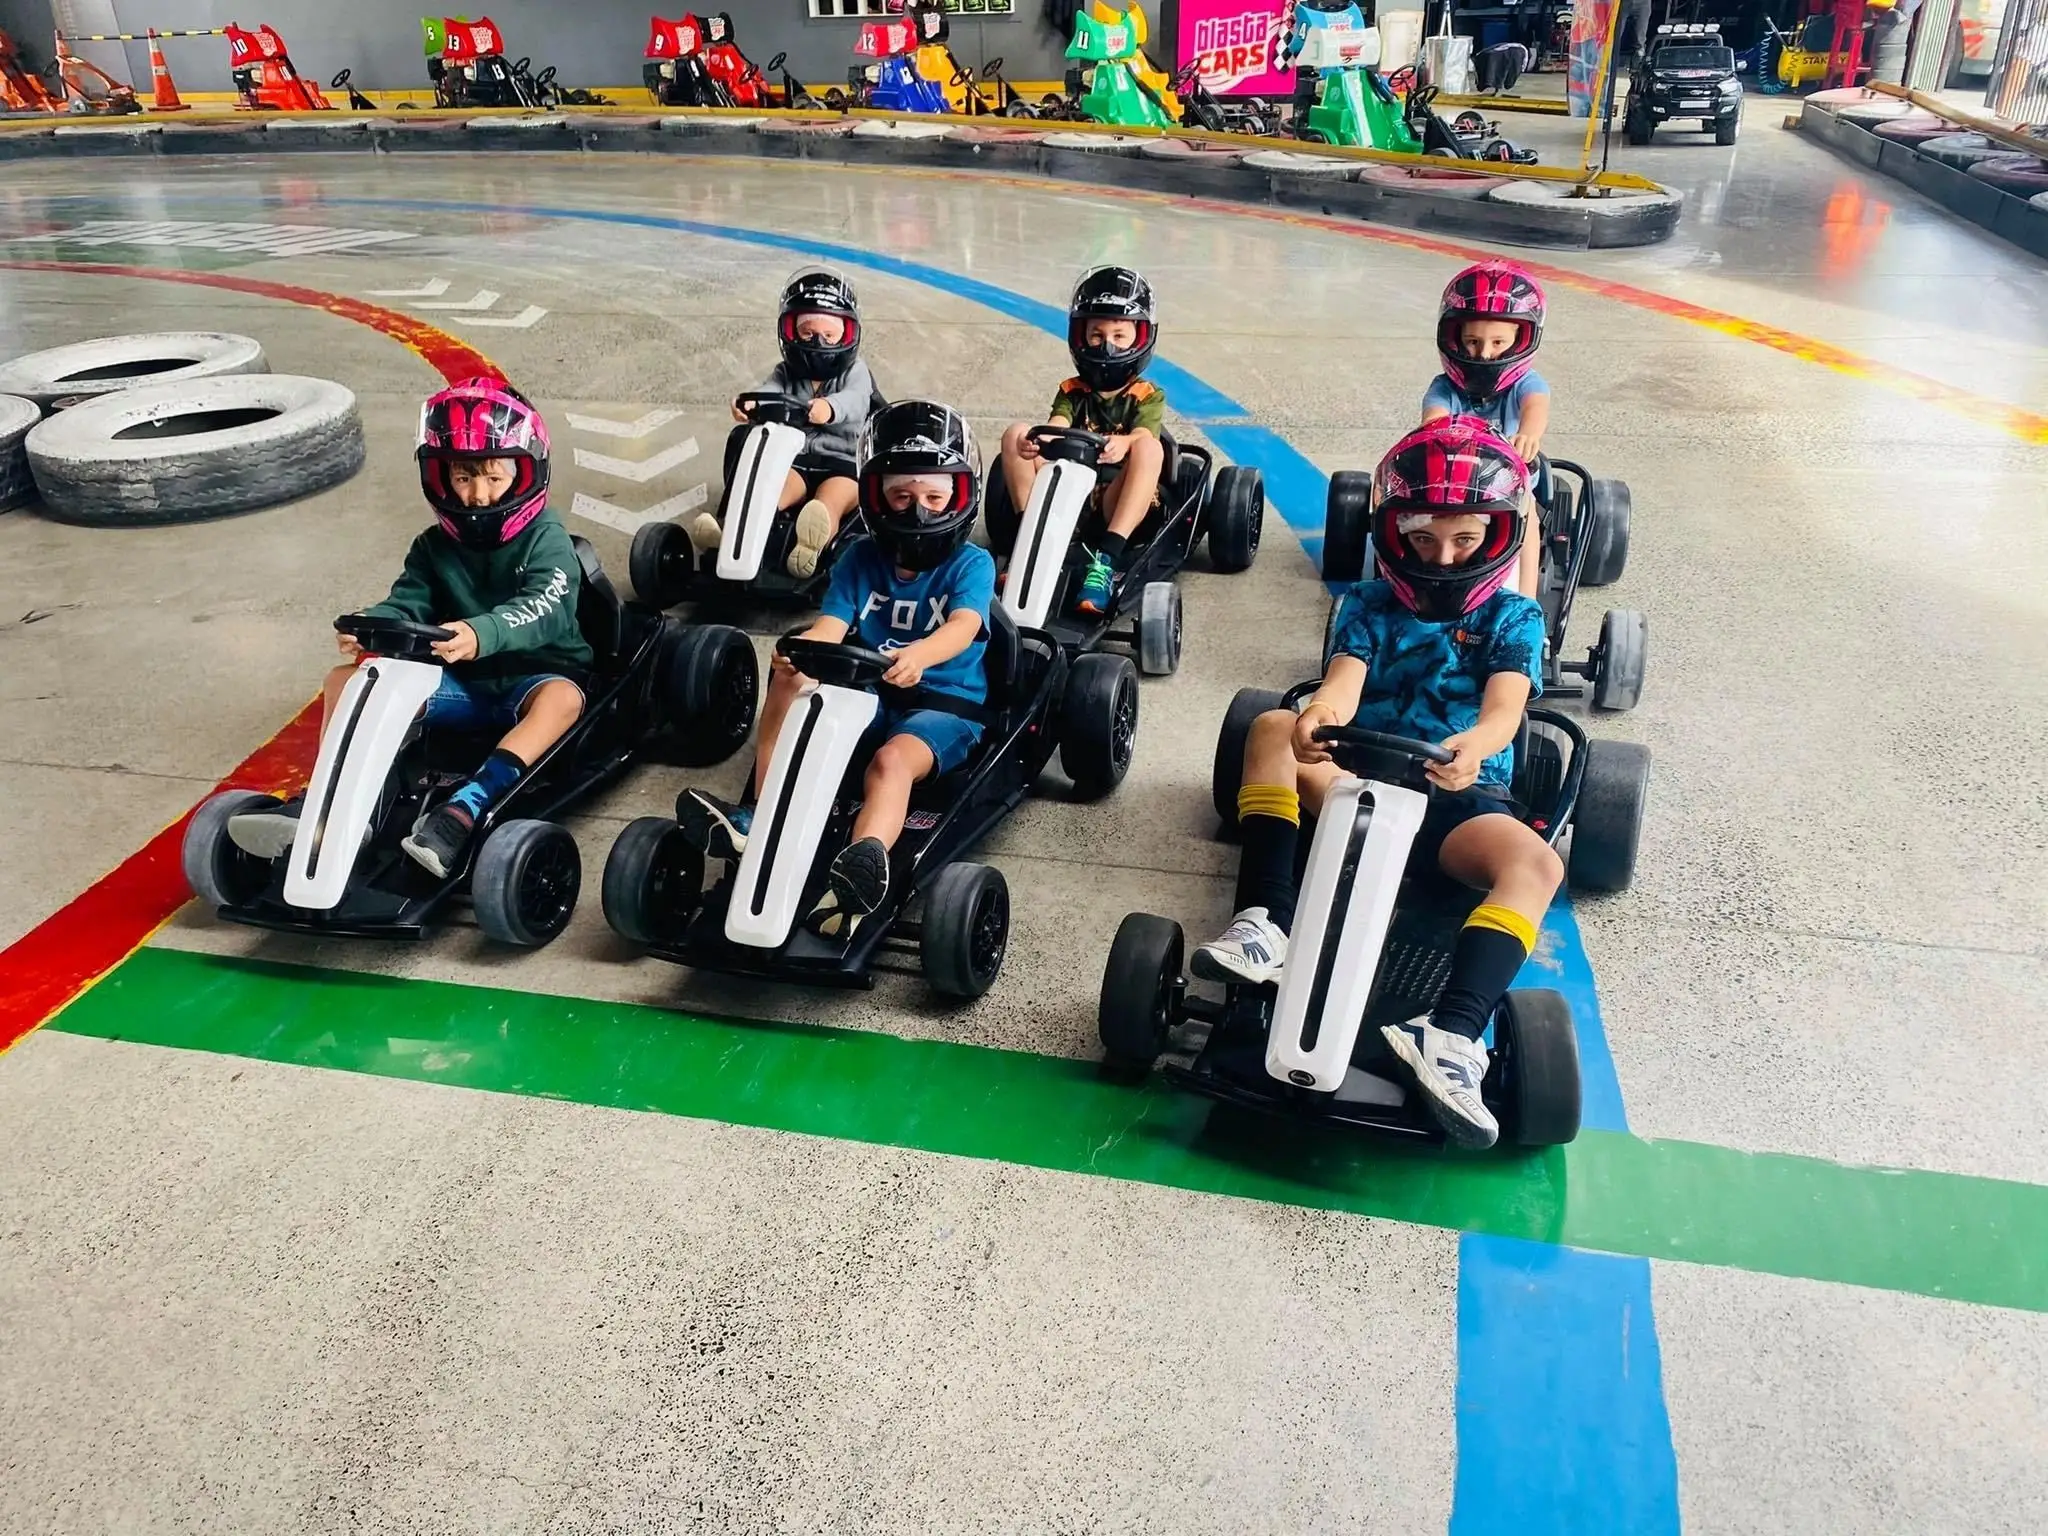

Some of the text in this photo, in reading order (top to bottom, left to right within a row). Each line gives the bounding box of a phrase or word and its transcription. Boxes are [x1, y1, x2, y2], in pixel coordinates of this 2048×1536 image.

[427, 26, 435, 41] 5
[1077, 30, 1089, 50] 11
[1299, 22, 1307, 40] 4
[232, 38, 248, 57] 10
[447, 34, 460, 51] 13
[655, 33, 664, 51] 9
[862, 33, 875, 50] 12
[1199, 43, 1266, 76] CARS
[1803, 55, 1847, 65] STANY
[859, 590, 949, 632] FOX
